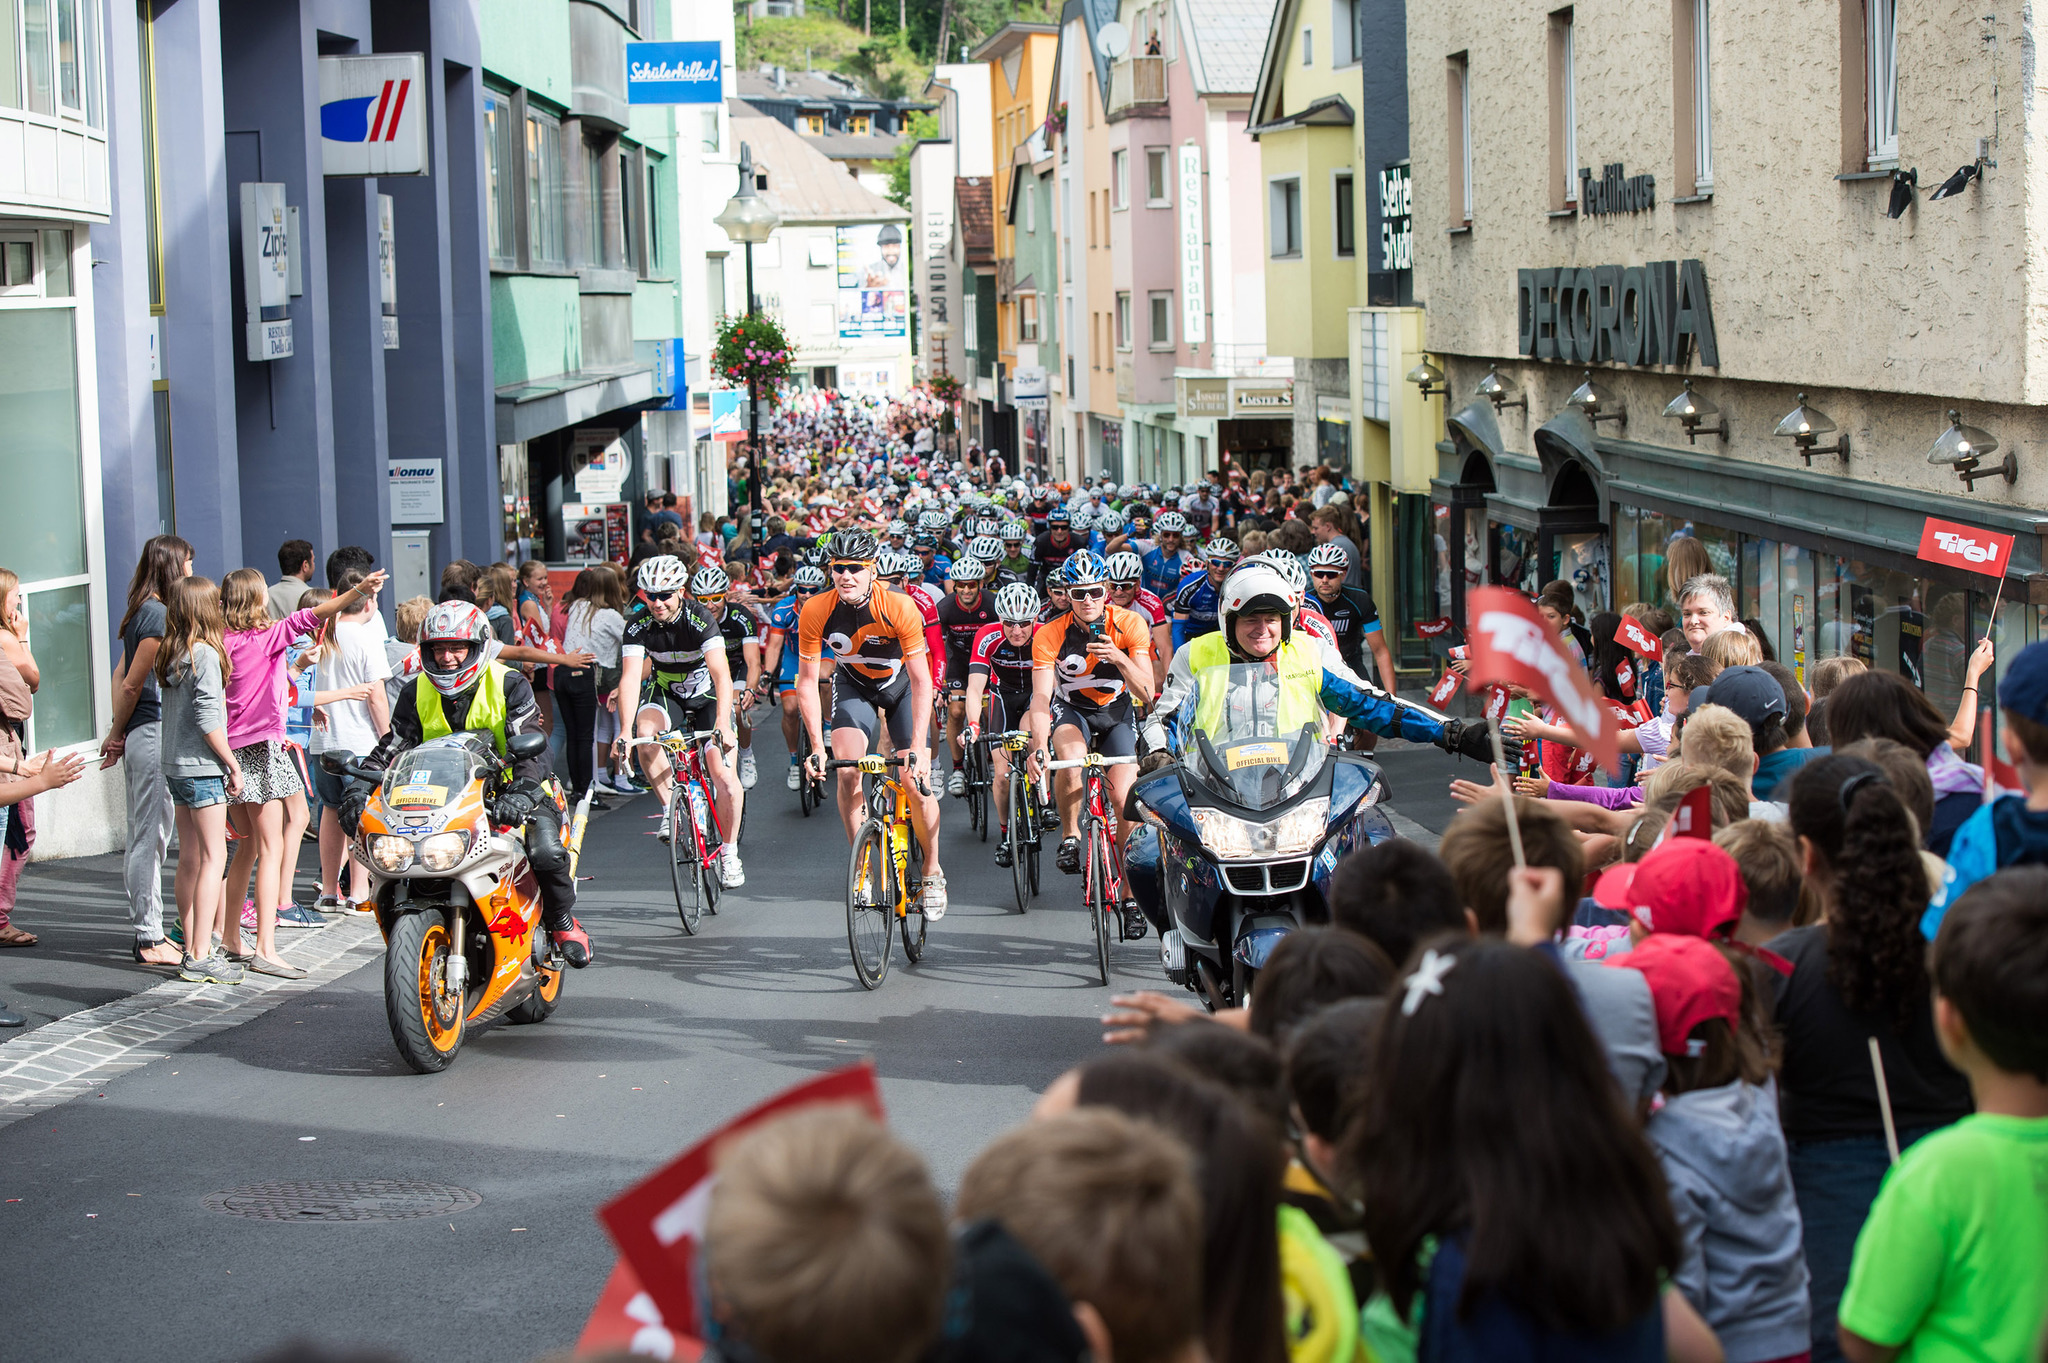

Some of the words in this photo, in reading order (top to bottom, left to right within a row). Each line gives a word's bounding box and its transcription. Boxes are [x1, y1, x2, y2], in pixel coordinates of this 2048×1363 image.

[1380, 168, 1412, 218] Bette
[1579, 163, 1655, 216] Textilhaus
[262, 225, 288, 263] Zipfe
[1184, 156, 1201, 332] Restaurant
[1382, 219, 1413, 270] Studi
[1518, 258, 1720, 368] DECORONA
[1934, 531, 1999, 563] Tirol
[979, 631, 1001, 656] BIEHLER
[1625, 624, 1656, 652] Tirol
[1434, 674, 1456, 703] Tirol
[1478, 610, 1602, 740] Tirol
[860, 761, 876, 771] 110
[1084, 755, 1099, 765] 110
[1236, 758, 1265, 767] OFFICIAL
[1266, 756, 1281, 764] BIKE
[396, 797, 421, 805] OFFICIAL
